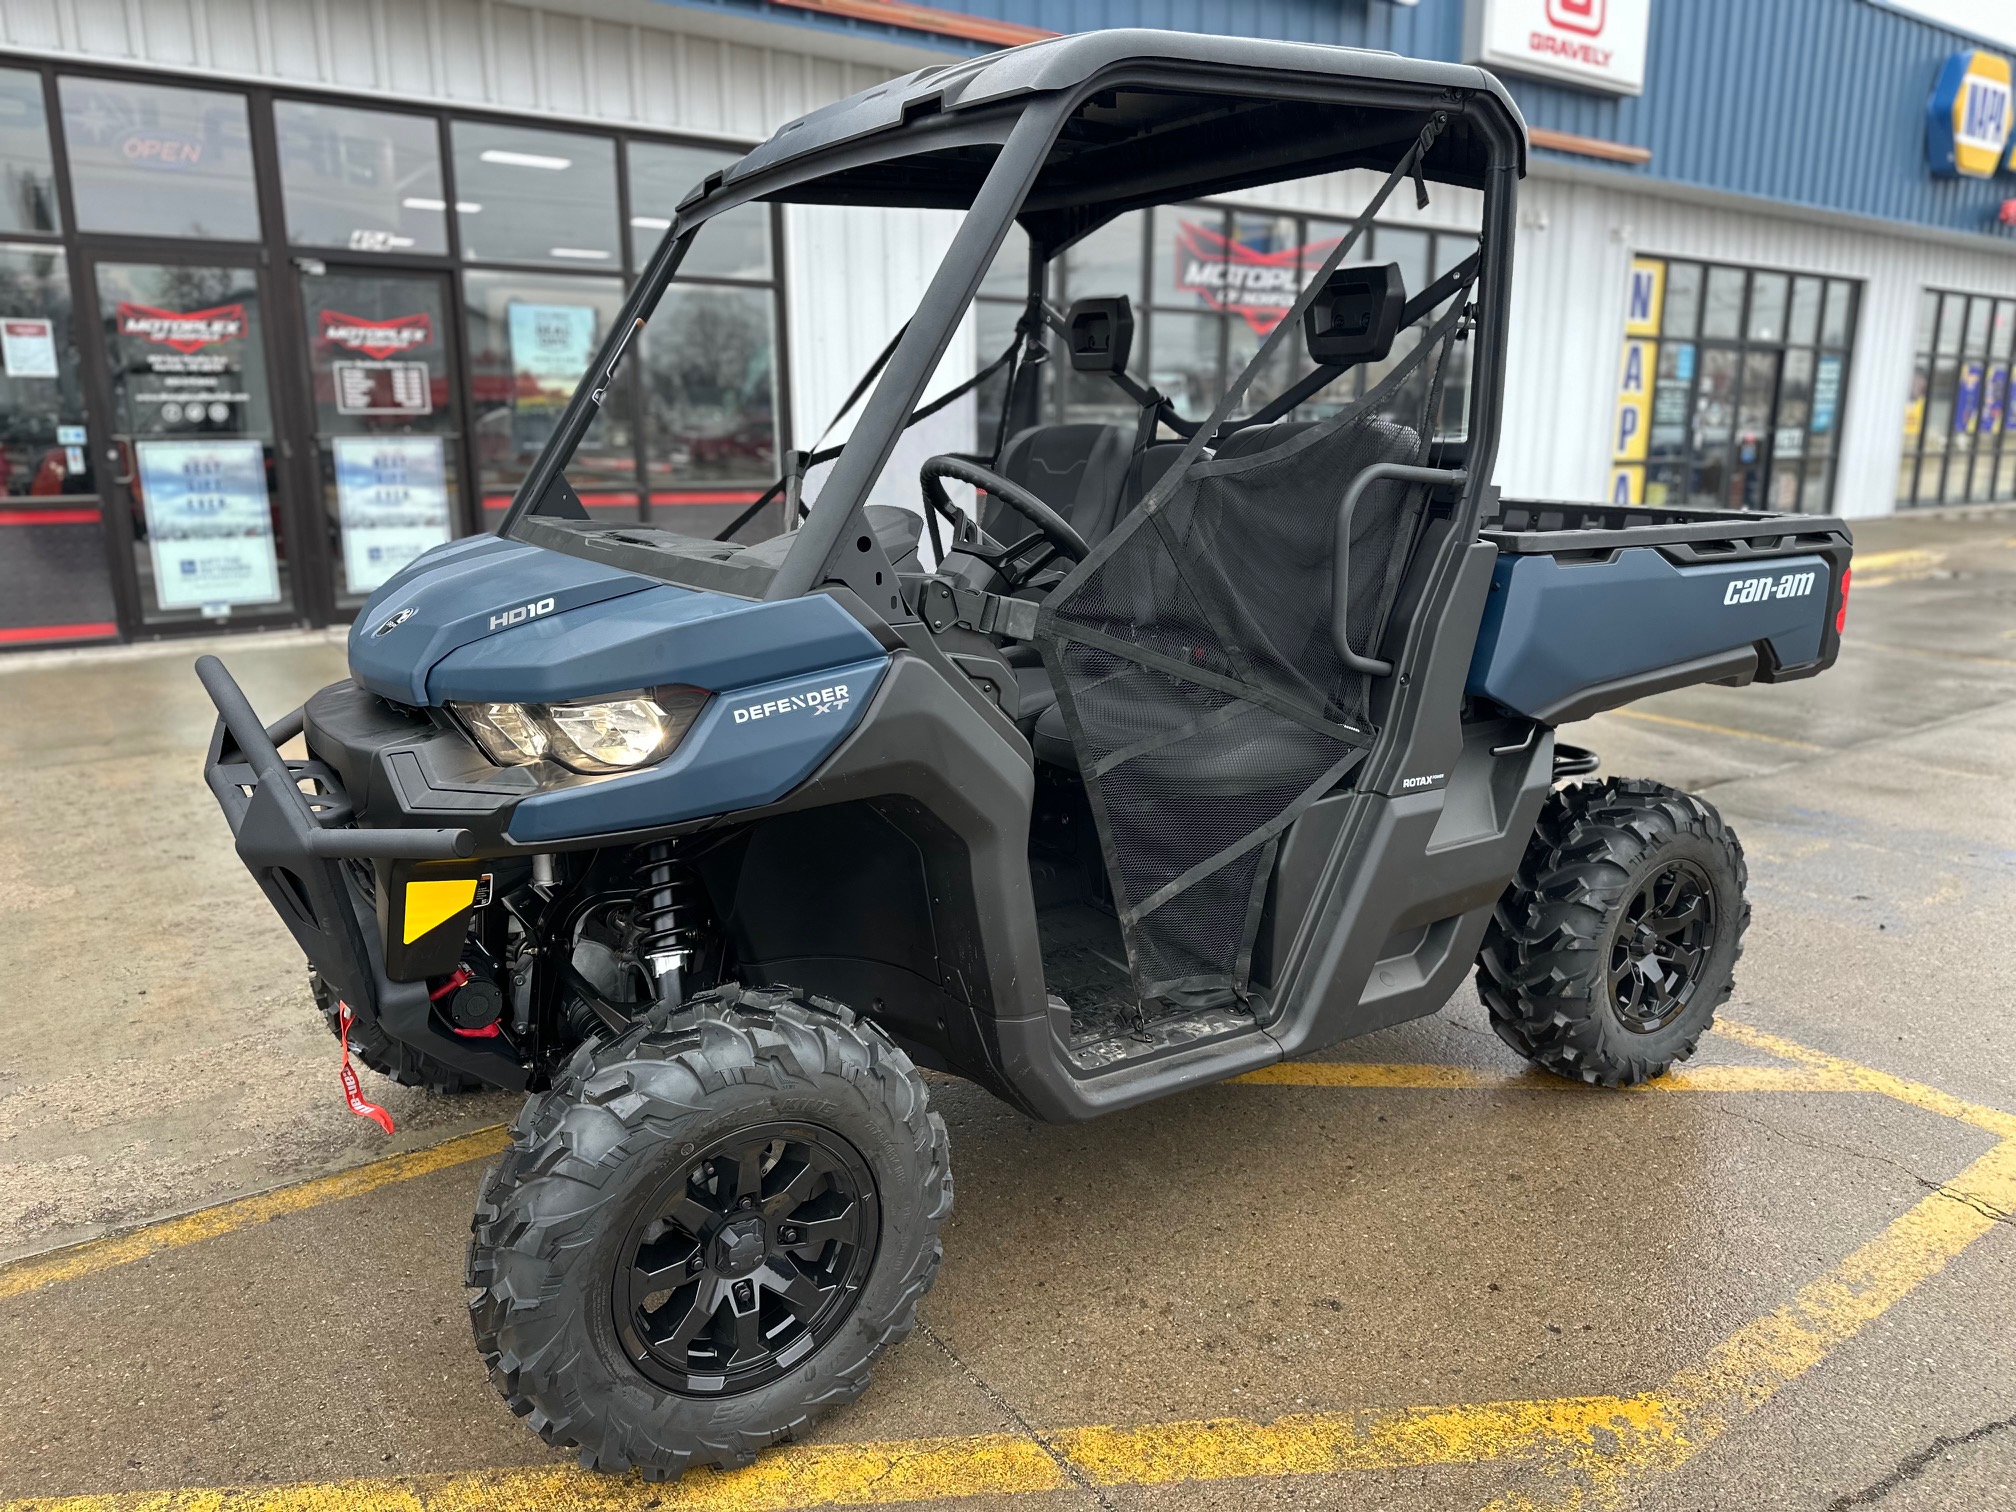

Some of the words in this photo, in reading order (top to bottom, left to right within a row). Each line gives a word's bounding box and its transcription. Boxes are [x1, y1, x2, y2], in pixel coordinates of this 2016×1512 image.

[1529, 32, 1612, 66] GRAVELY
[1965, 82, 2006, 143] NAPA
[122, 136, 202, 163] OPEN
[124, 317, 241, 336] MOTOPLEX
[325, 326, 427, 342] MOTOPLEX
[1723, 572, 1816, 605] can-am
[490, 597, 555, 630] HD10
[733, 685, 850, 724] DEFENDER
[814, 698, 850, 716] XT
[1402, 776, 1433, 788] ROTAX
[781, 1097, 839, 1113] KING
